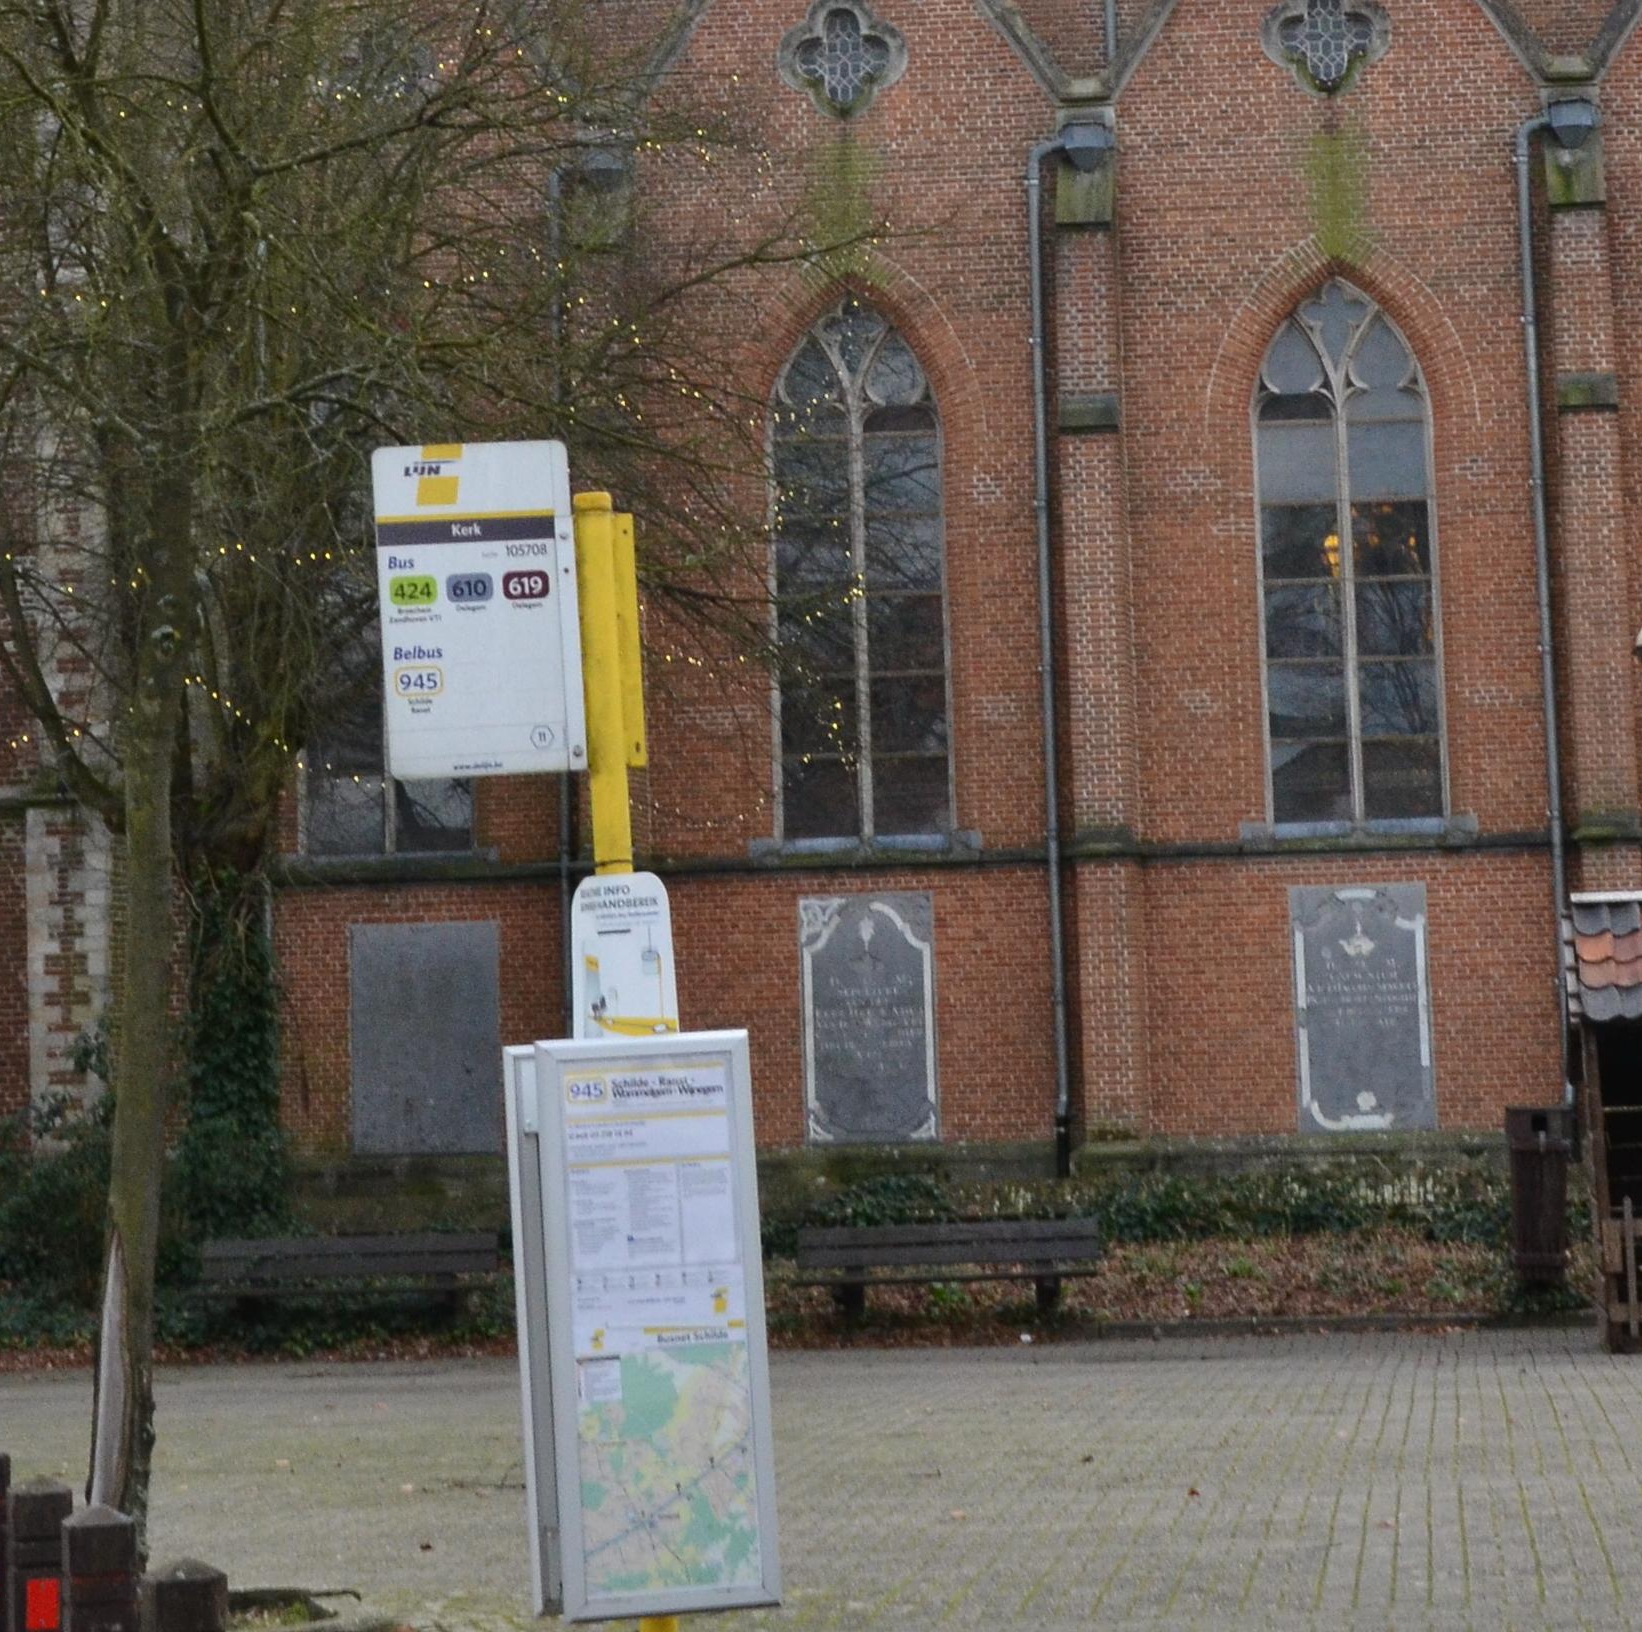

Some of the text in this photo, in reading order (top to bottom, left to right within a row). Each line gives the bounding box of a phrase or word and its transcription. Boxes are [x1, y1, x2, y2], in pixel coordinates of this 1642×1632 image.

[451, 523, 482, 537] Kerk
[506, 544, 547, 557] 105708
[388, 556, 415, 569] Bus
[394, 582, 432, 600] 424
[452, 579, 487, 597] 610
[509, 576, 543, 595] 619
[393, 646, 443, 661] Belbus
[399, 673, 438, 690] 945
[603, 885, 630, 896] INFO
[570, 1083, 603, 1099] 945
